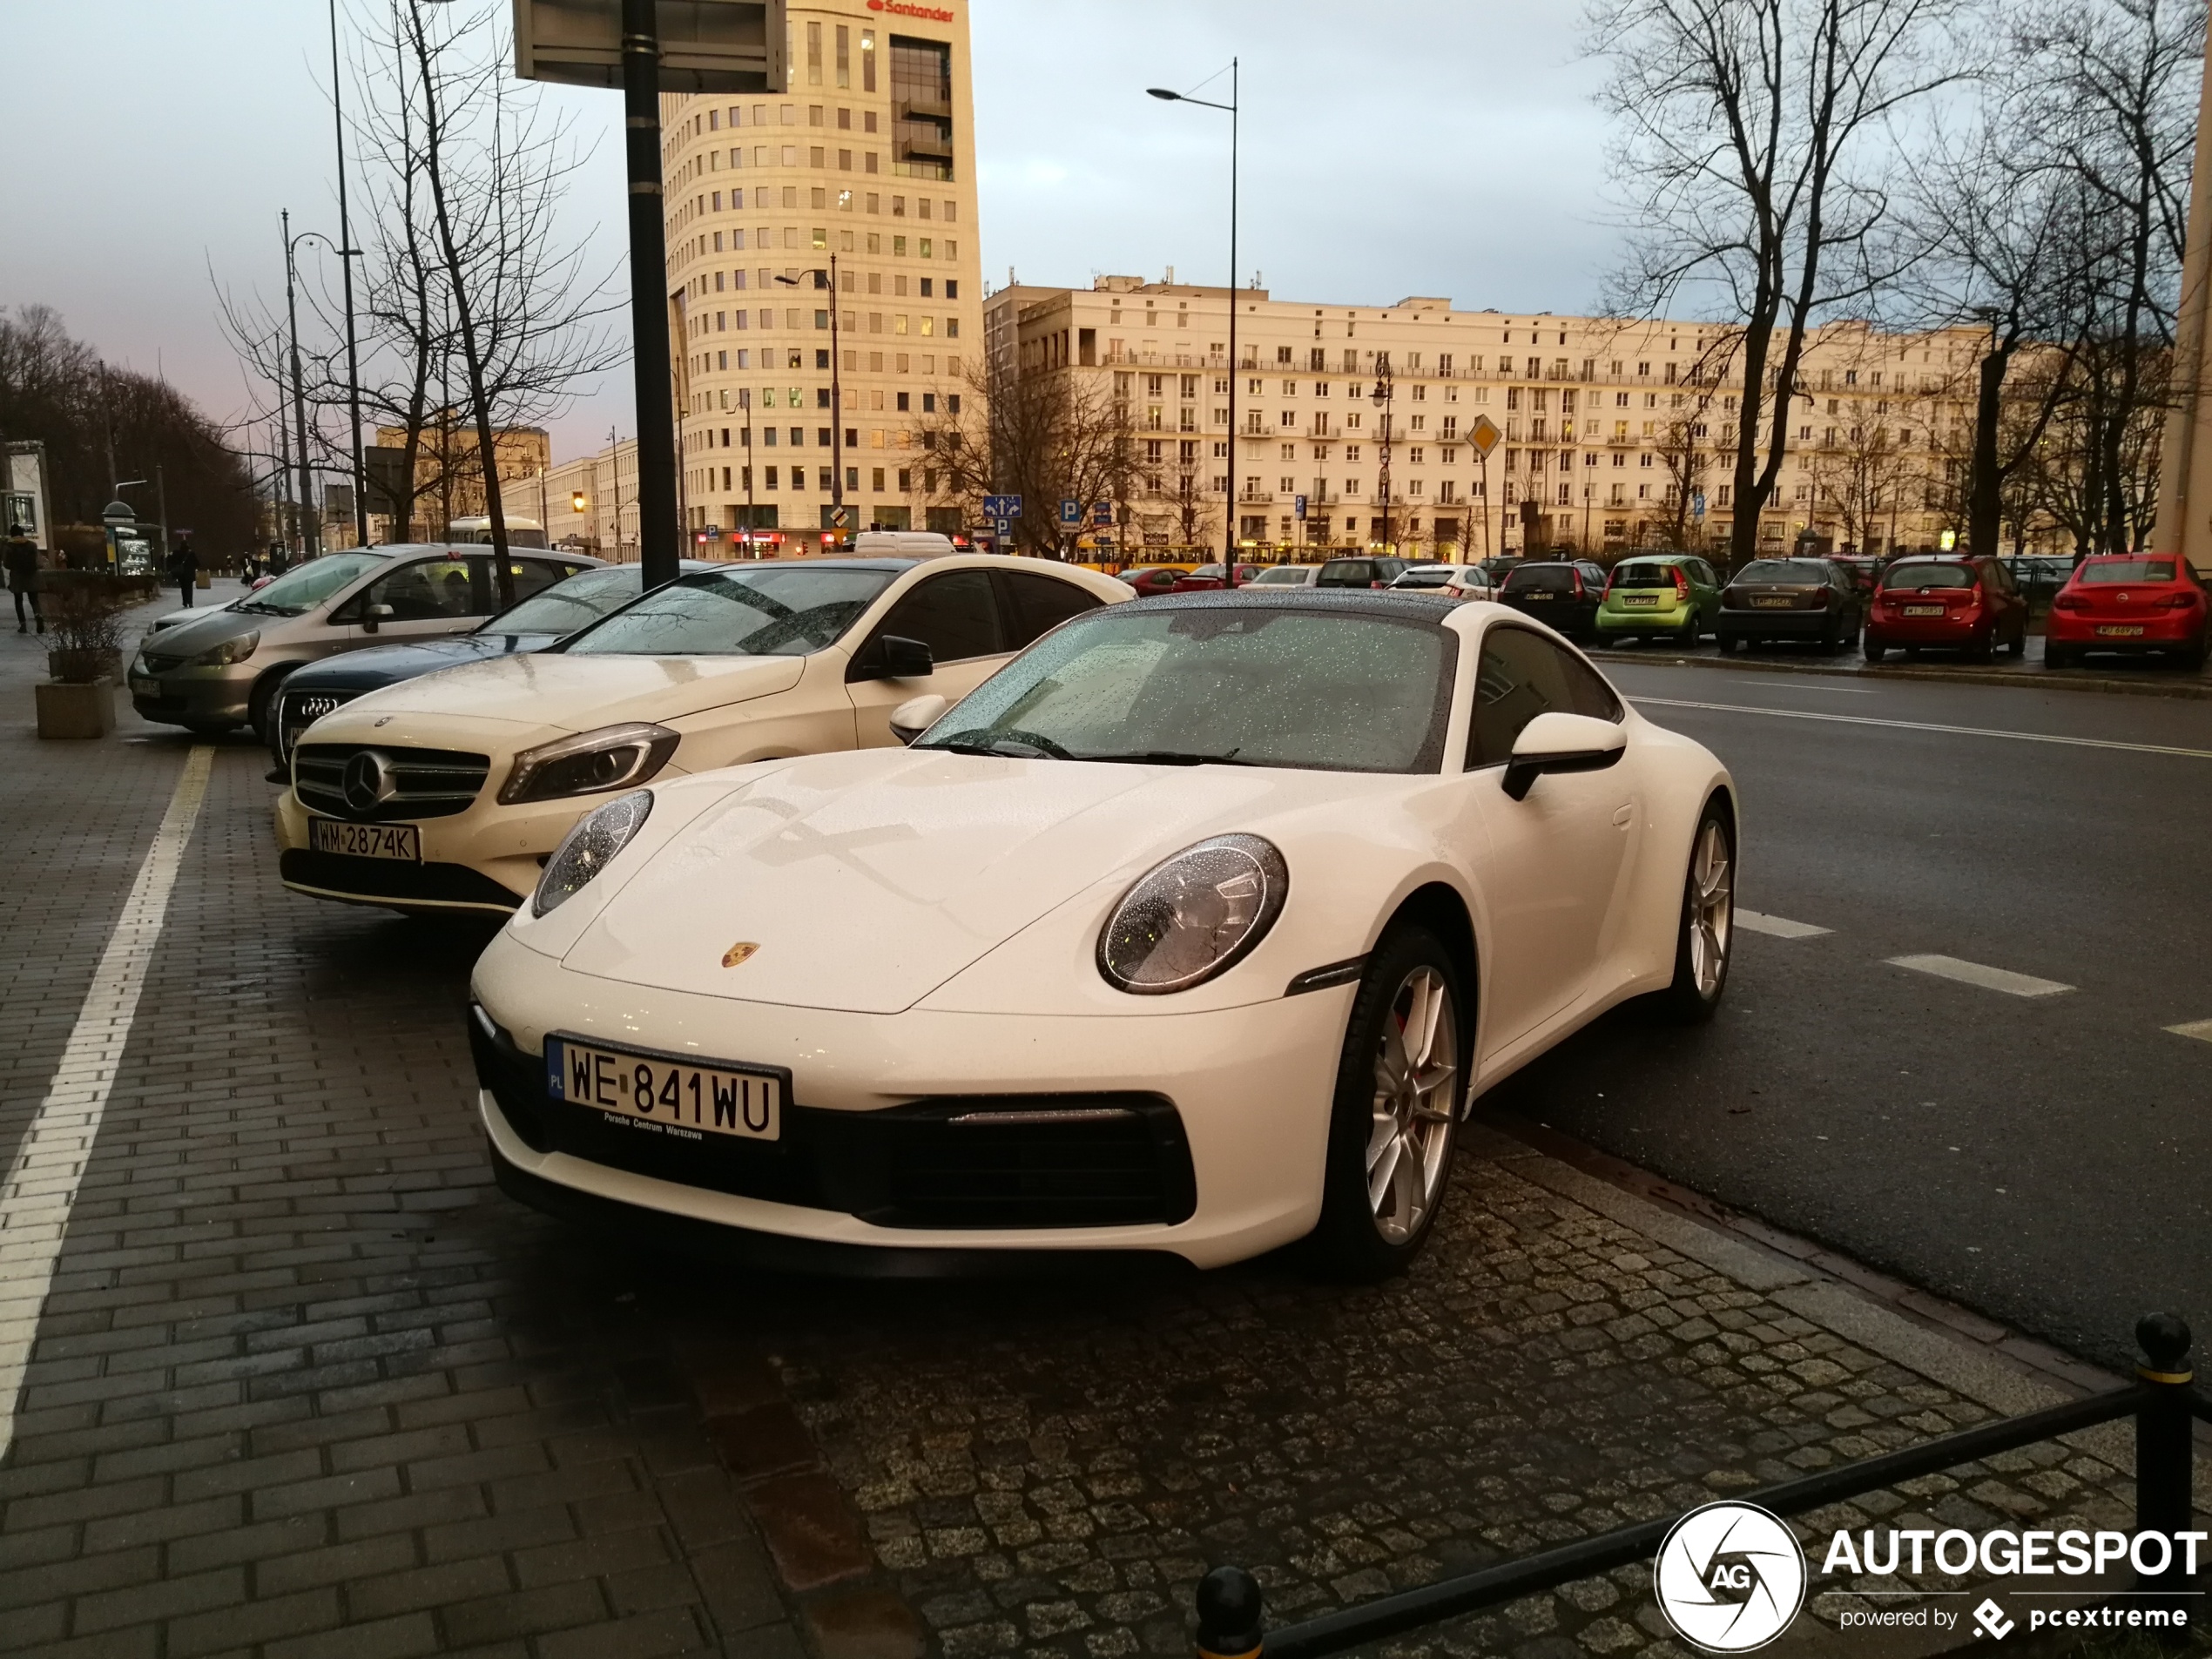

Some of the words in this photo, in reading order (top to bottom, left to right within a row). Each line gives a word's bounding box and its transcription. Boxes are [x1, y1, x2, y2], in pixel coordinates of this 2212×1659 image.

[885, 0, 954, 22] Santander
[1065, 502, 1076, 520] P
[709, 526, 715, 536] P
[998, 519, 1008, 535] P
[320, 823, 341, 852] WM
[347, 826, 410, 858] 2874K
[550, 1075, 563, 1089] PL
[570, 1049, 617, 1107] WE
[634, 1062, 770, 1133] 841WU
[604, 1111, 631, 1126] Porsche
[633, 1117, 663, 1133] Centrum
[665, 1124, 703, 1141] Warszawa
